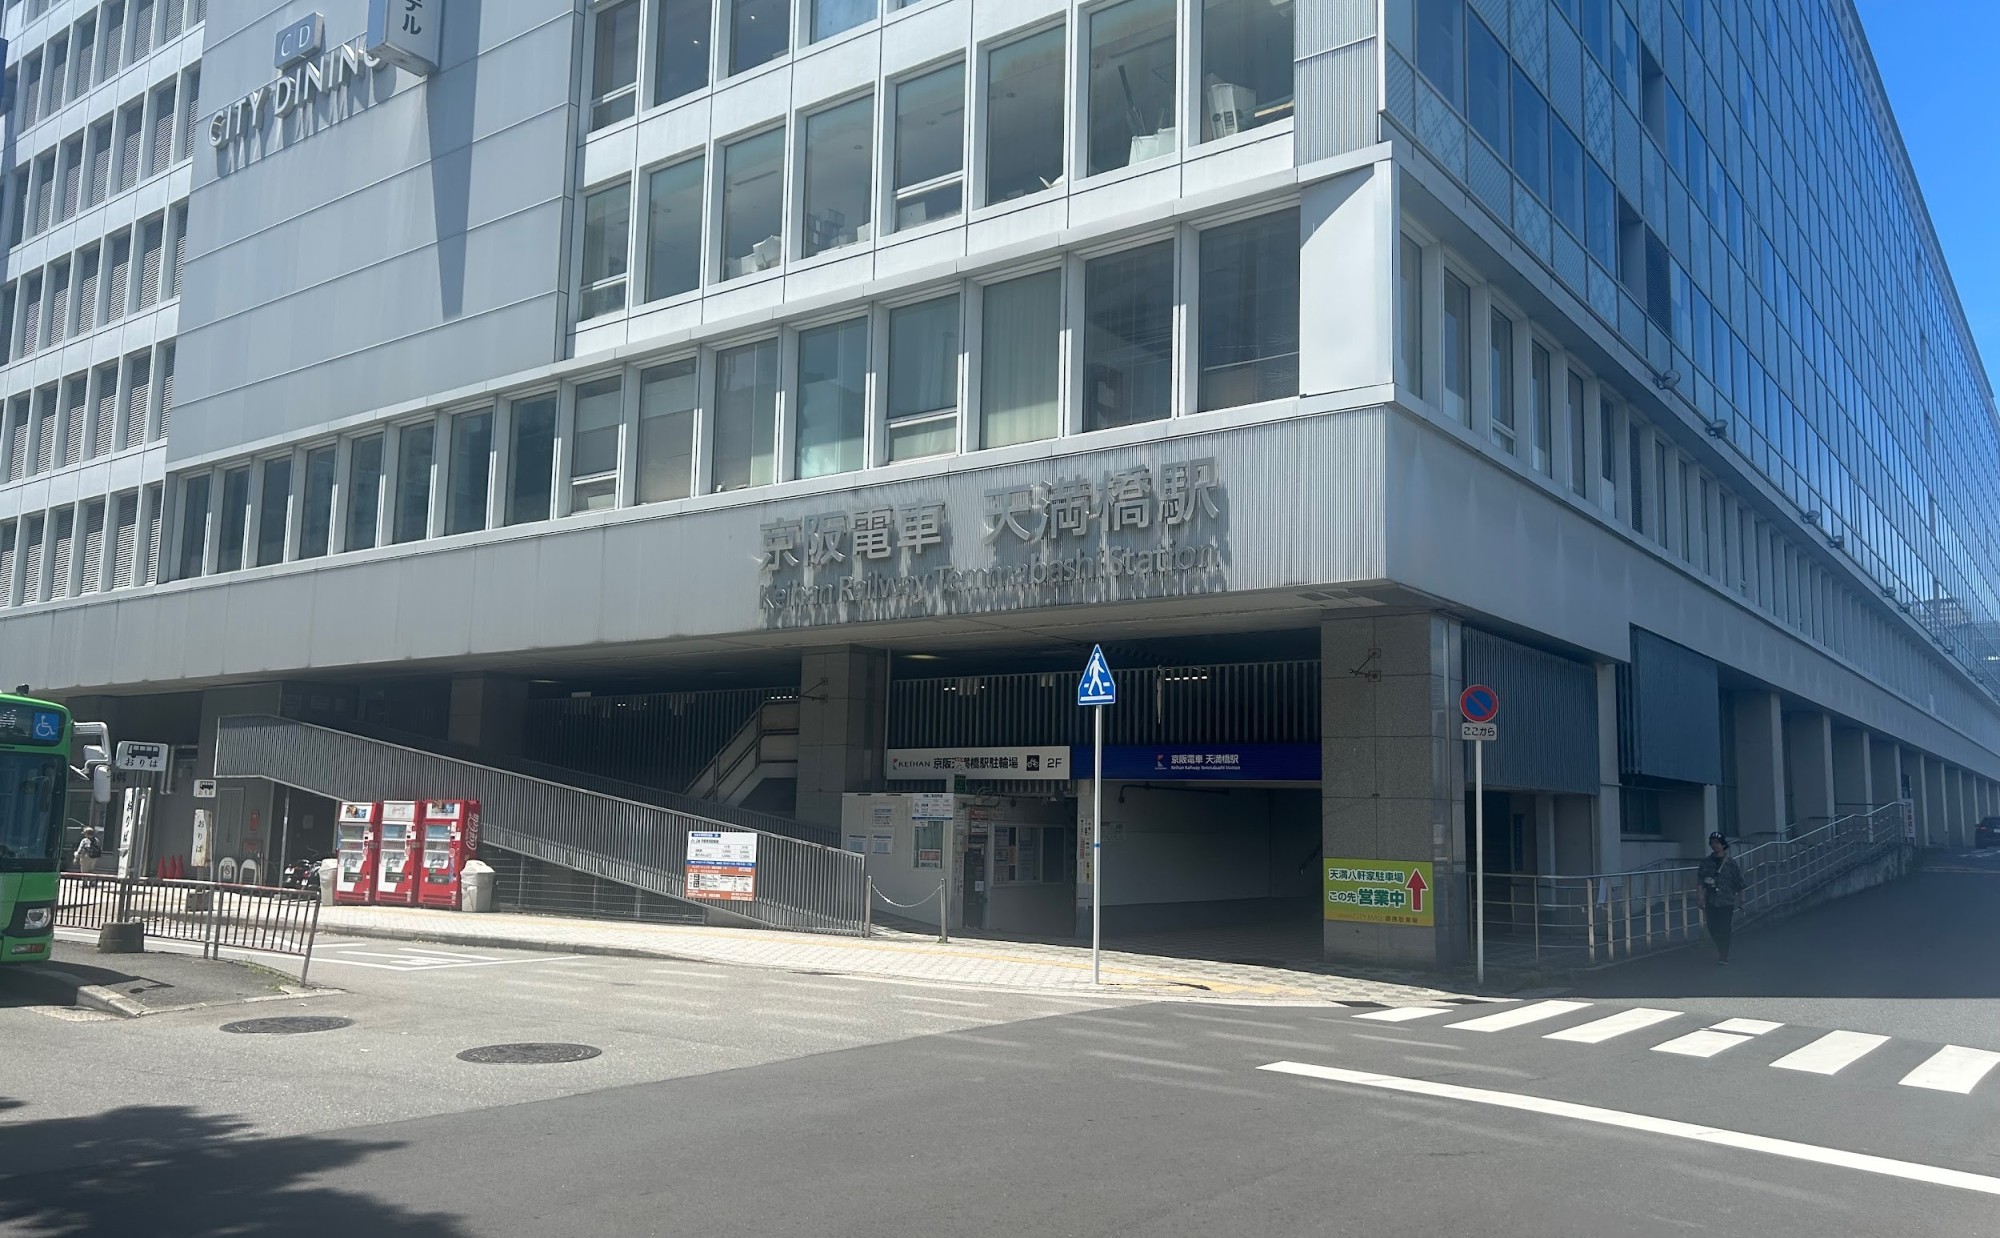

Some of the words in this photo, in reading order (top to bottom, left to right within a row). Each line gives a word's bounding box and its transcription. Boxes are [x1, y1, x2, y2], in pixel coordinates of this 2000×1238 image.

[208, 88, 266, 148] CITY
[758, 499, 946, 571] 京阪電車
[981, 456, 1220, 546] 天満橋駅
[760, 578, 834, 610] Keihan
[839, 570, 930, 604] Railway
[934, 547, 1102, 593] Temmabashi
[1104, 541, 1221, 577] Station
[1464, 727, 1495, 736] ここから
[1047, 758, 1062, 768] 2F
[1171, 754, 1203, 764] 京阪電車
[1205, 754, 1239, 764] 天満橋駅
[1329, 869, 1404, 883] 天満八軒家駐車場
